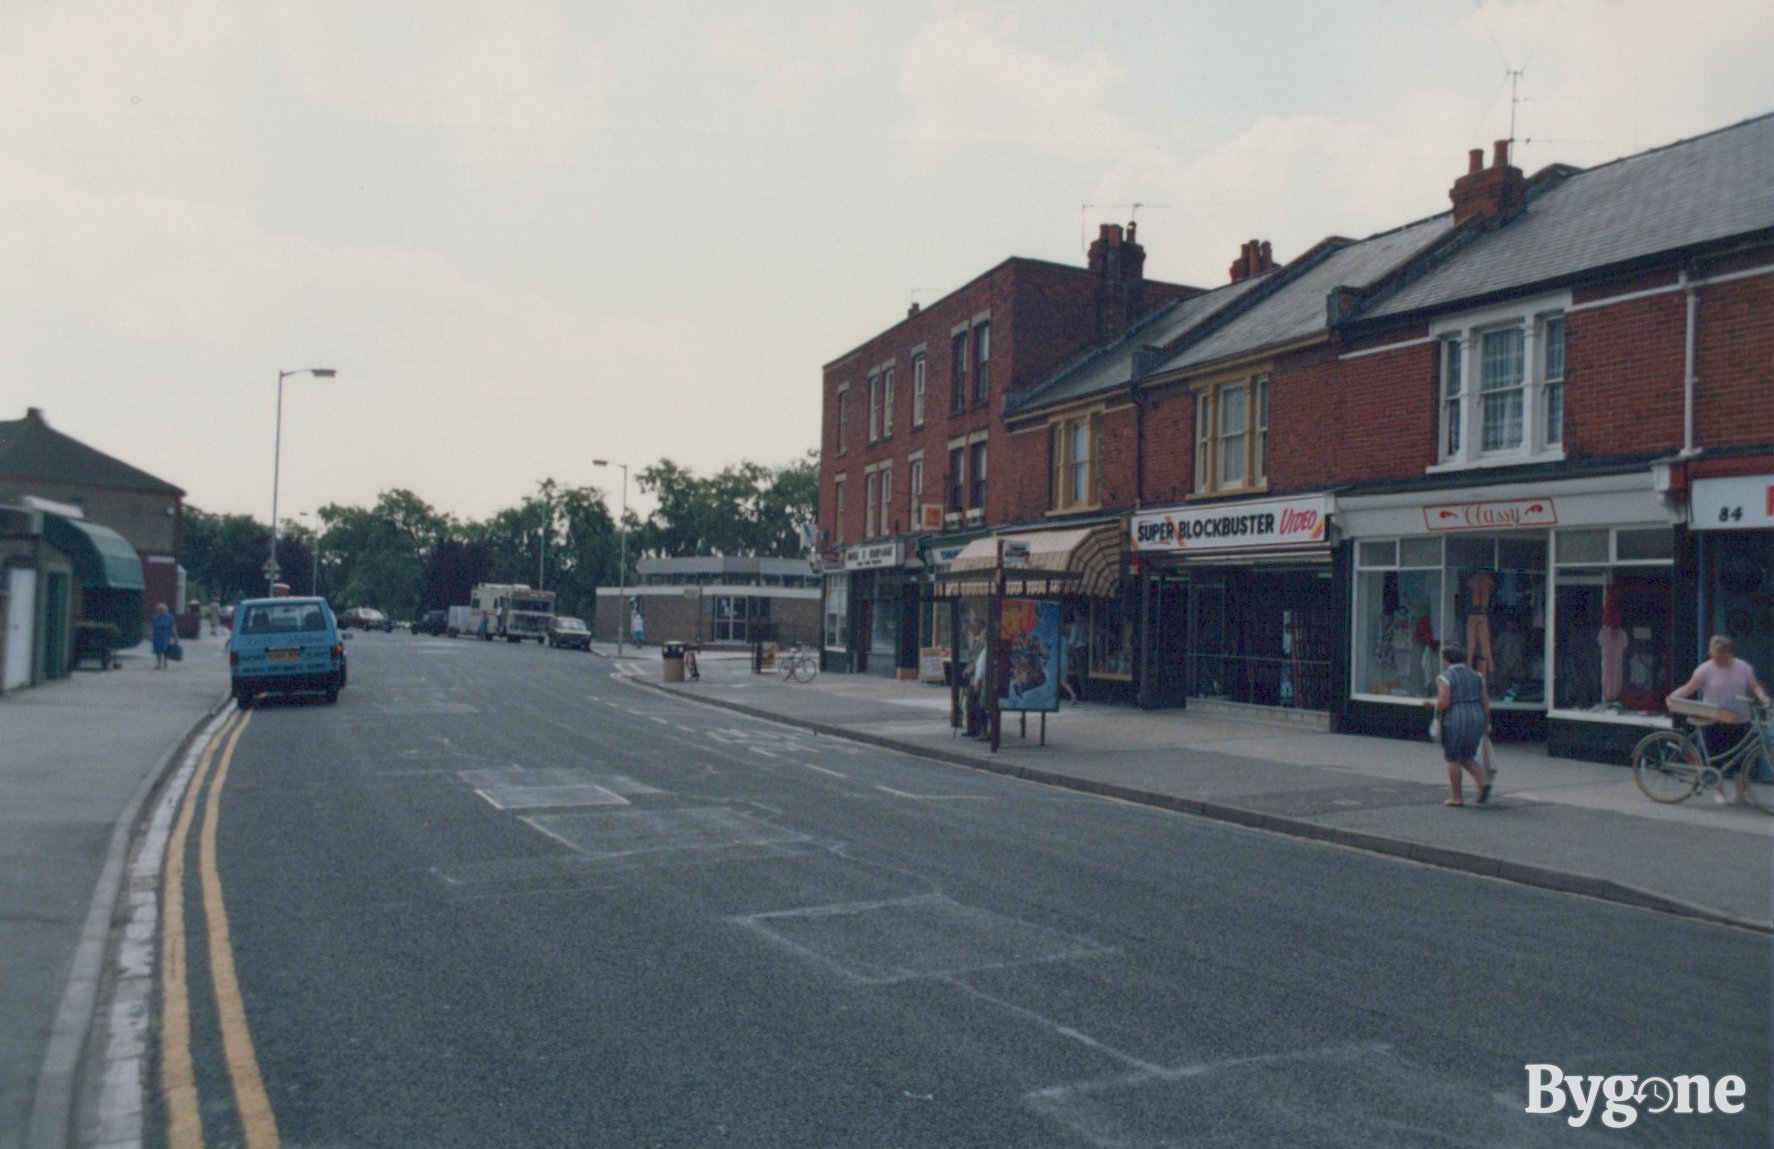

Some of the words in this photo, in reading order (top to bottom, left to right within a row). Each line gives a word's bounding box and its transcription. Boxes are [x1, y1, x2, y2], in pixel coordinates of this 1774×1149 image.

[1718, 506, 1743, 522] 84
[1137, 521, 1174, 542] SUPER
[1178, 513, 1274, 538] BLOCKBUSTER
